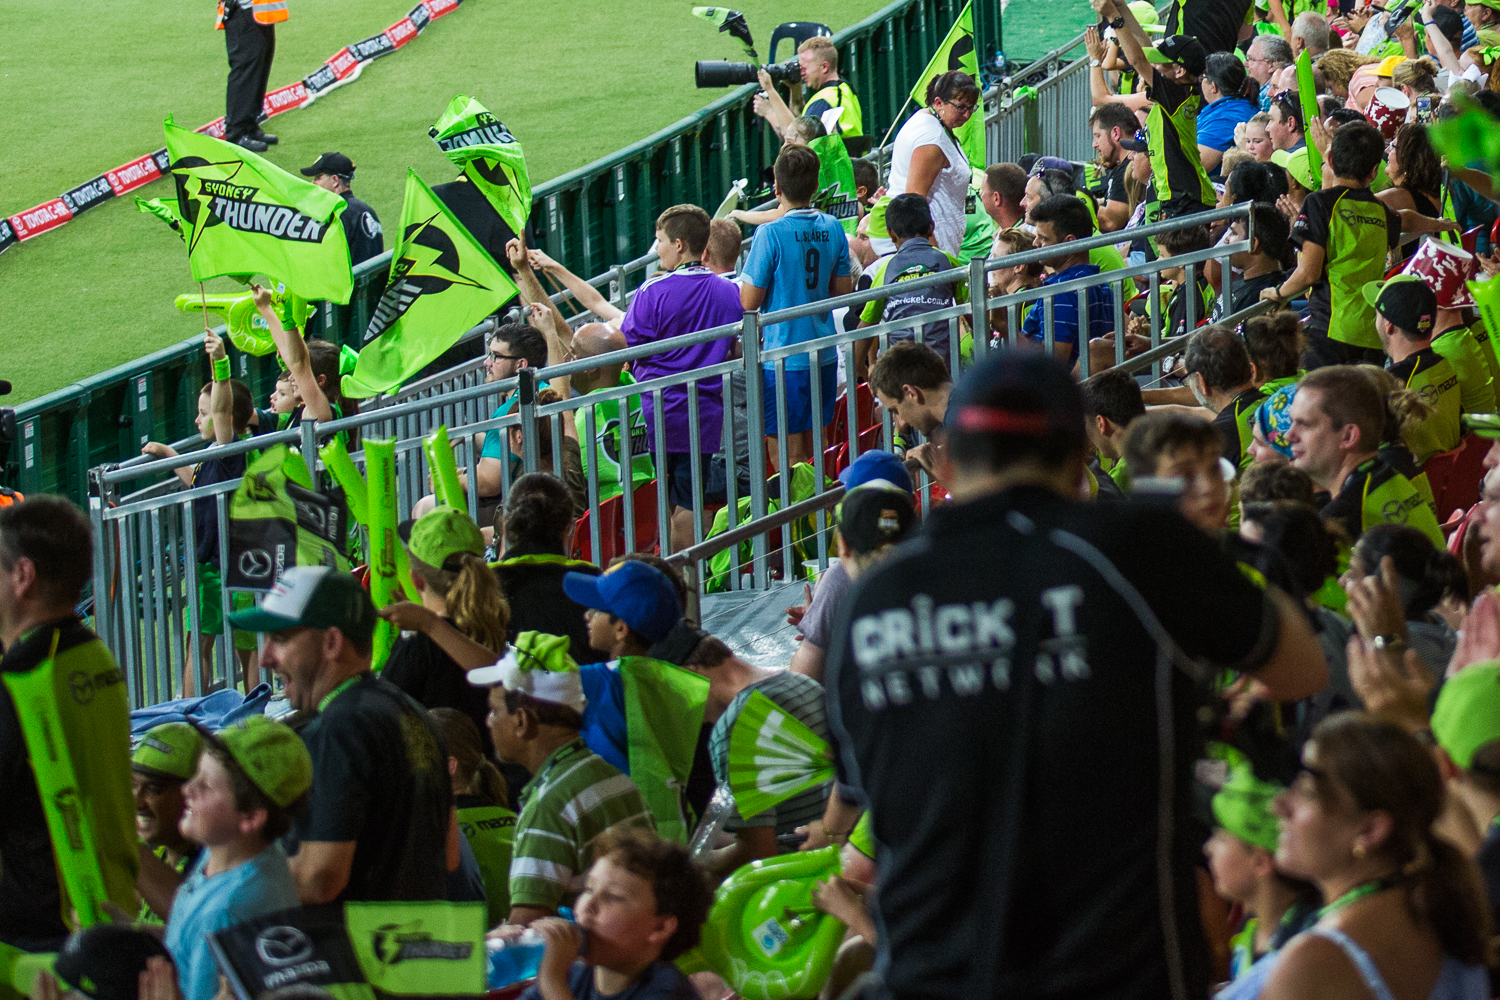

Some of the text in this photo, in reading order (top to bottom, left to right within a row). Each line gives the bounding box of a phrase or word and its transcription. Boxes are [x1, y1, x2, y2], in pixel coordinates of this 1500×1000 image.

[117, 162, 143, 186] TOYOTA
[71, 182, 98, 208] TOYOTA
[205, 181, 253, 200] SYDNEY
[22, 199, 71, 230] TOYOTA C-HR
[805, 248, 820, 291] 9
[852, 584, 1085, 672] CRICKT
[263, 959, 331, 989] mazda
